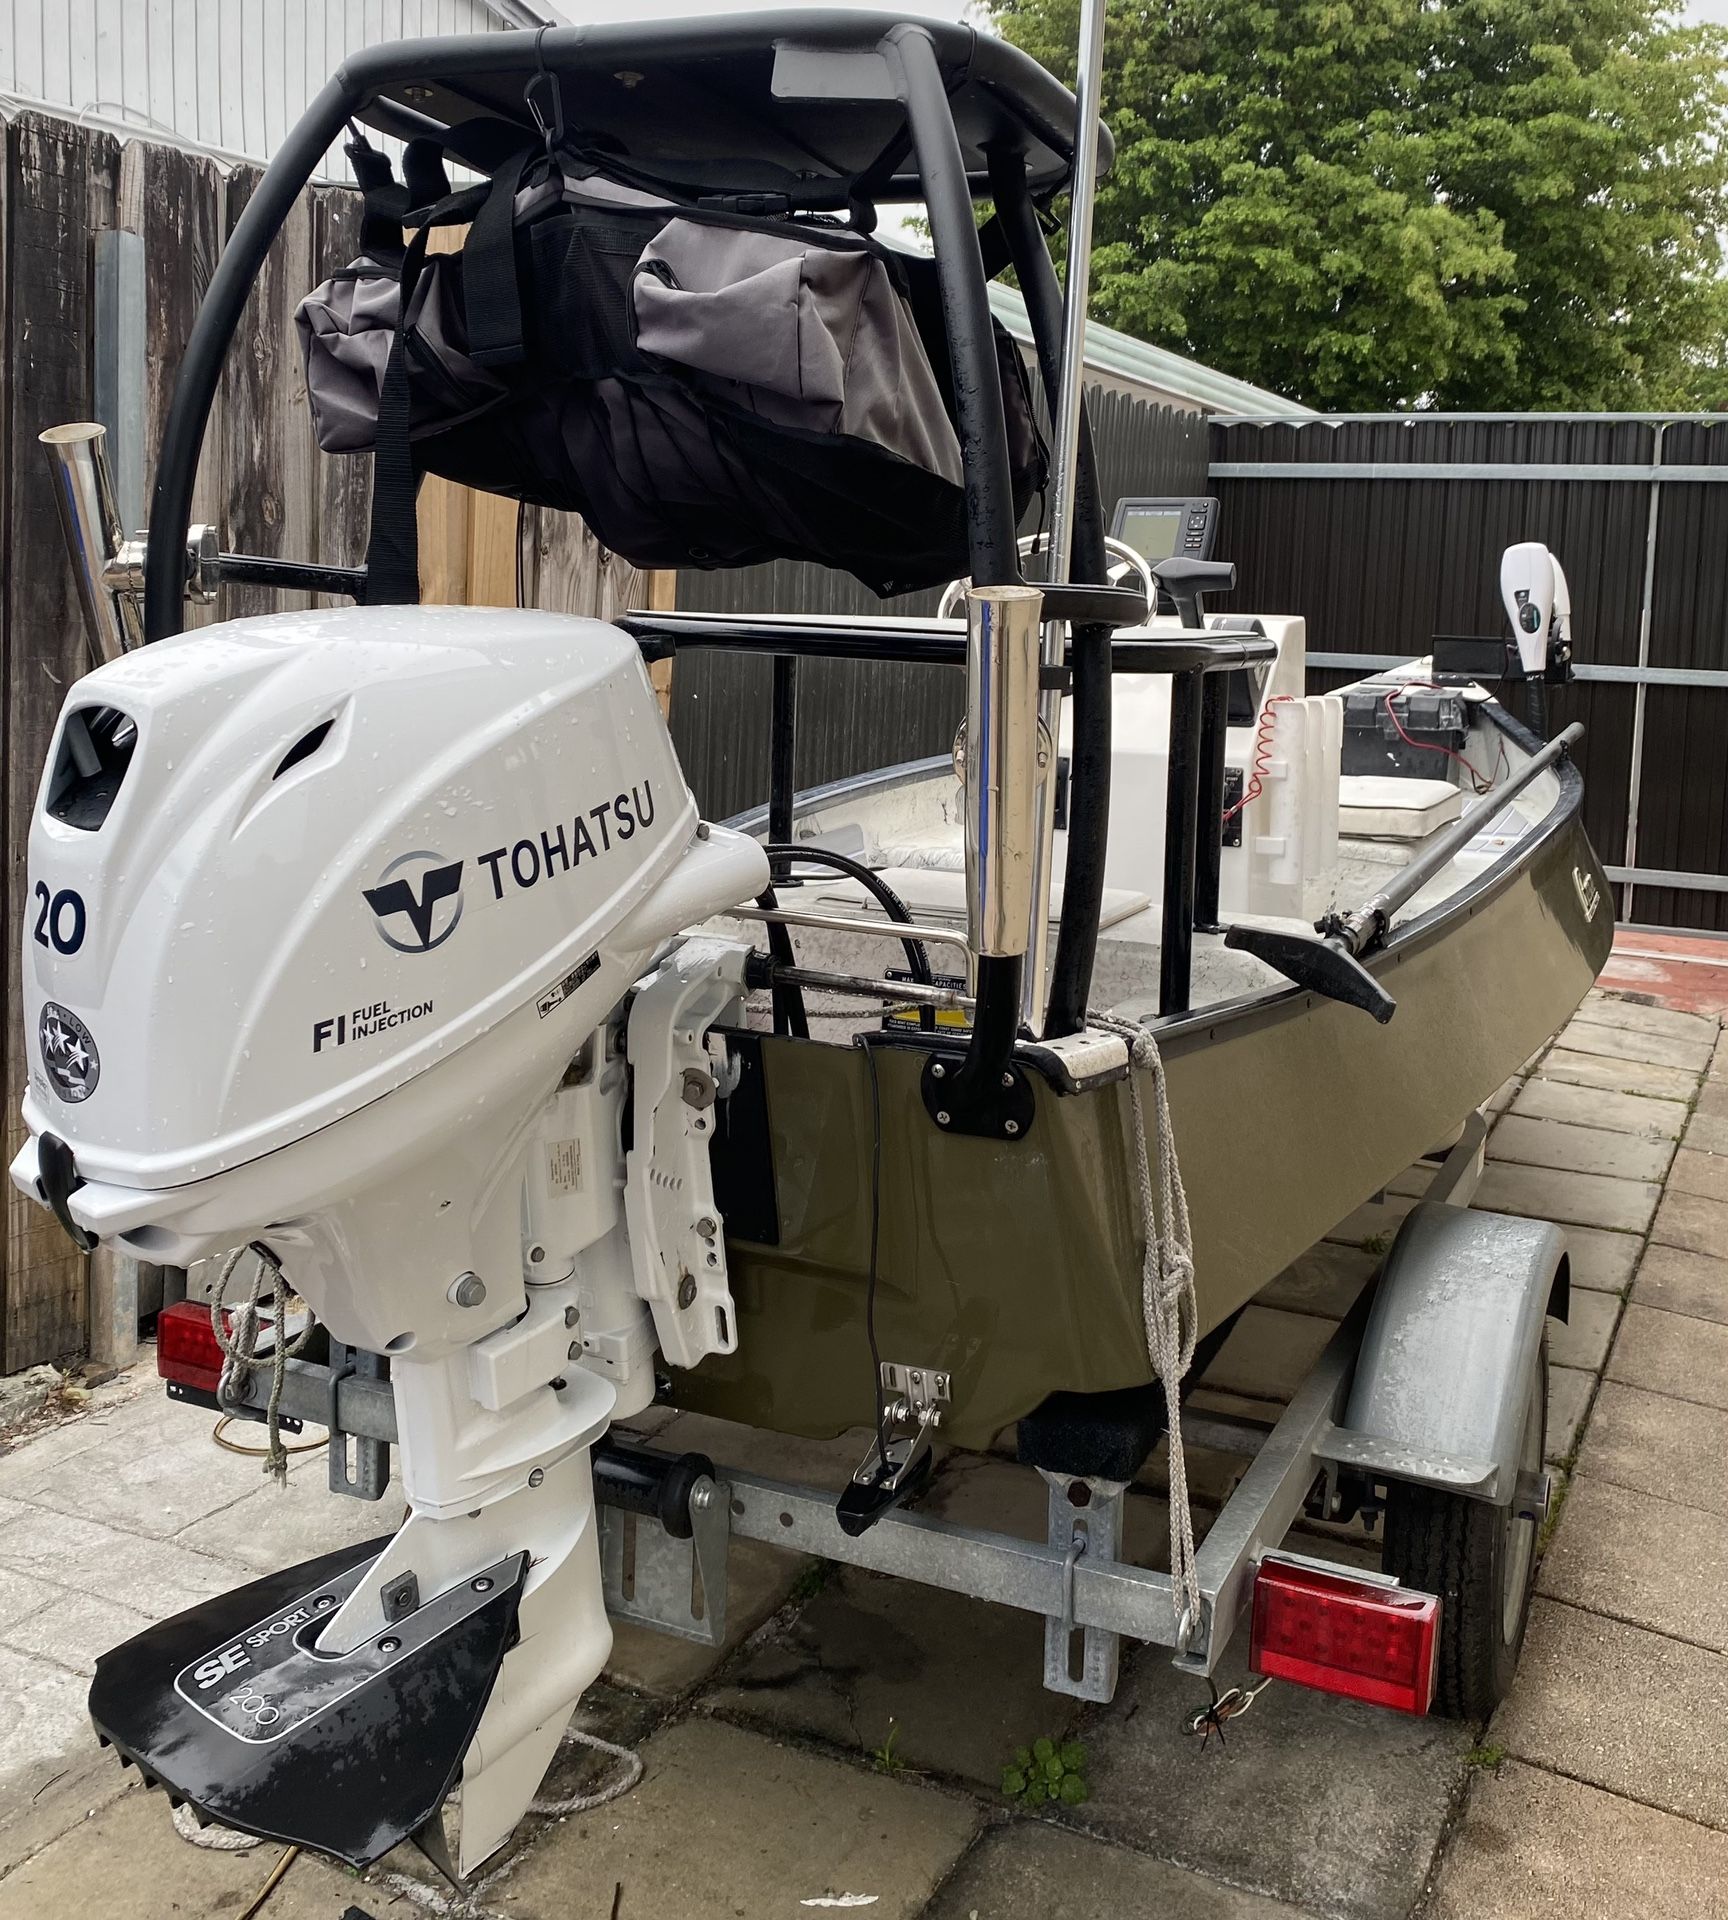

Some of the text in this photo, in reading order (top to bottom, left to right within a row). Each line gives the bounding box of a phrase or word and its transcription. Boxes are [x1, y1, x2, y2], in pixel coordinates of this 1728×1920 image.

[477, 780, 655, 900] TOHATSU
[34, 880, 87, 955] 20
[69, 1017, 92, 1044] LOW
[352, 1001, 391, 1025] FUEL
[352, 1000, 434, 1041] INJECTION
[313, 1015, 346, 1053] FI
[193, 1607, 311, 1690] SE SPORT
[229, 1687, 280, 1725] 200
